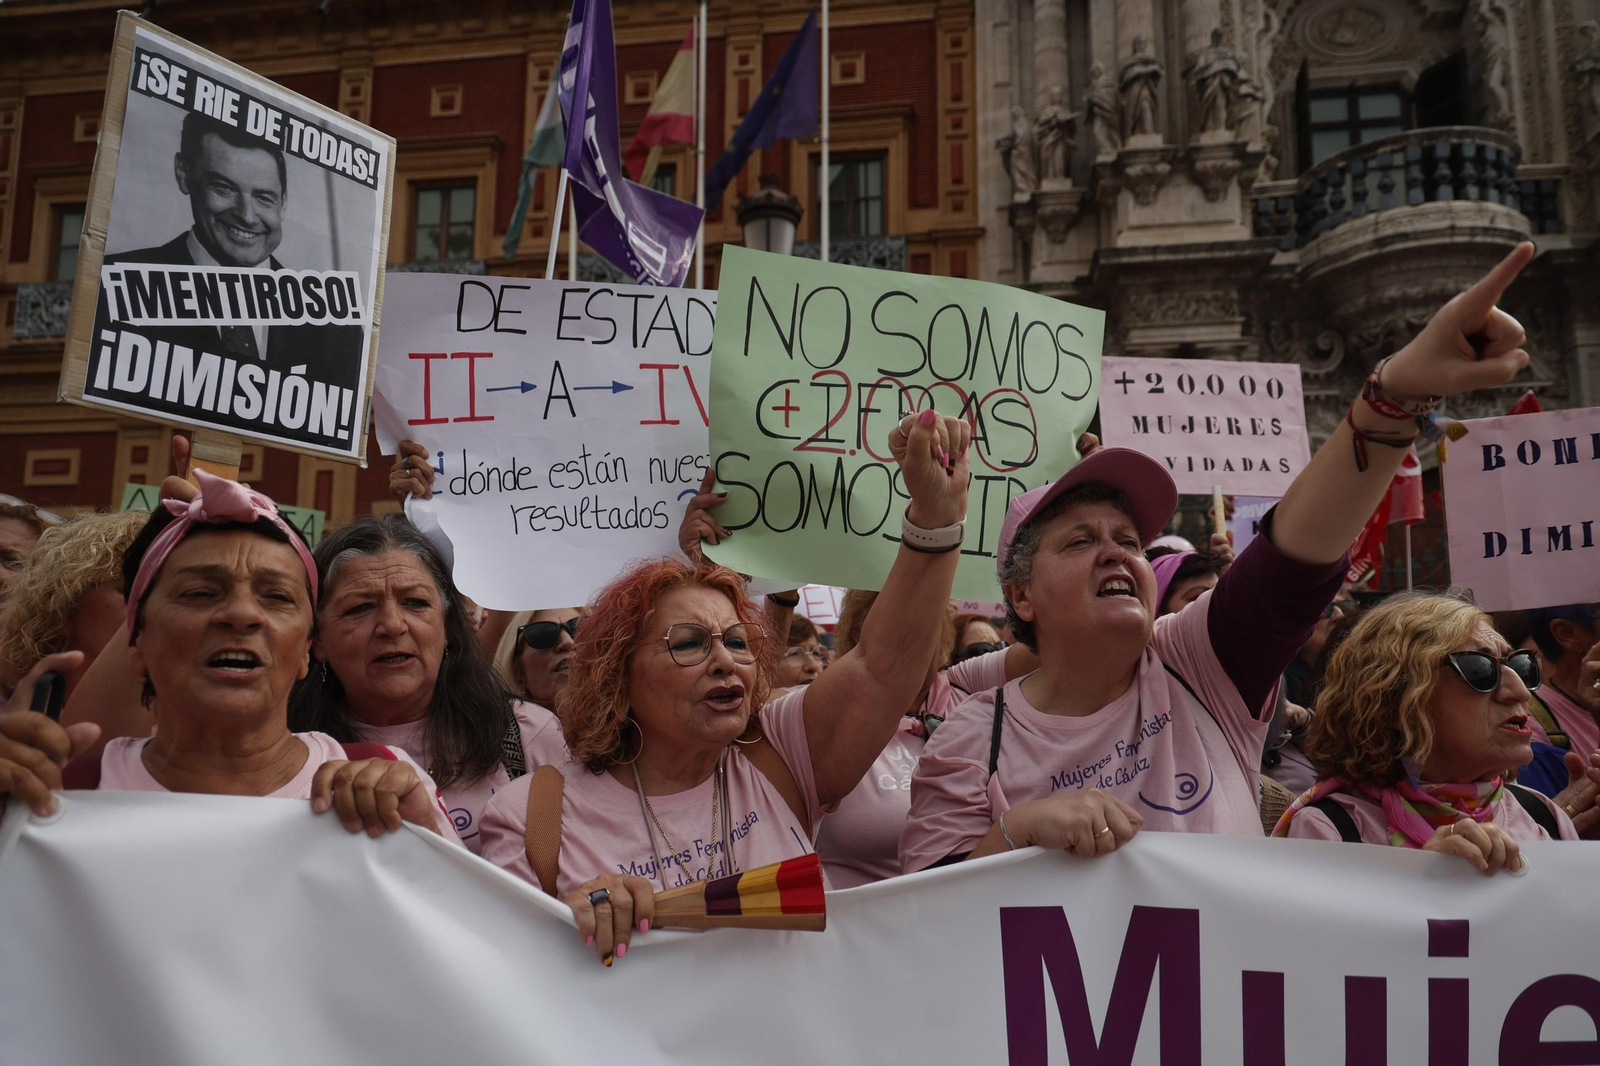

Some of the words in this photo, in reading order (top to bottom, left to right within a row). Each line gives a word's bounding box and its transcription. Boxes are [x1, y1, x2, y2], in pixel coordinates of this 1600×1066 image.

[137, 53, 187, 104] ¡SE
[194, 76, 239, 127] RIE
[246, 107, 282, 146] DE
[289, 121, 377, 185] TODAS!
[108, 269, 361, 322] ¡MENTIROSO!
[456, 280, 531, 335] DE
[556, 288, 717, 356] ESTAD
[743, 276, 851, 369] NO
[871, 290, 1093, 401] SOMOS
[94, 329, 354, 440] ¡DIMISIÓN!
[543, 360, 577, 420] A
[1132, 415, 1283, 436] MUJERES
[549, 443, 629, 491] están
[649, 453, 710, 485] nues
[1165, 456, 1291, 473] VIDADAS
[1481, 520, 1595, 559] DIMI
[1049, 753, 1112, 792] Mujeres
[1095, 773, 1113, 789] de
